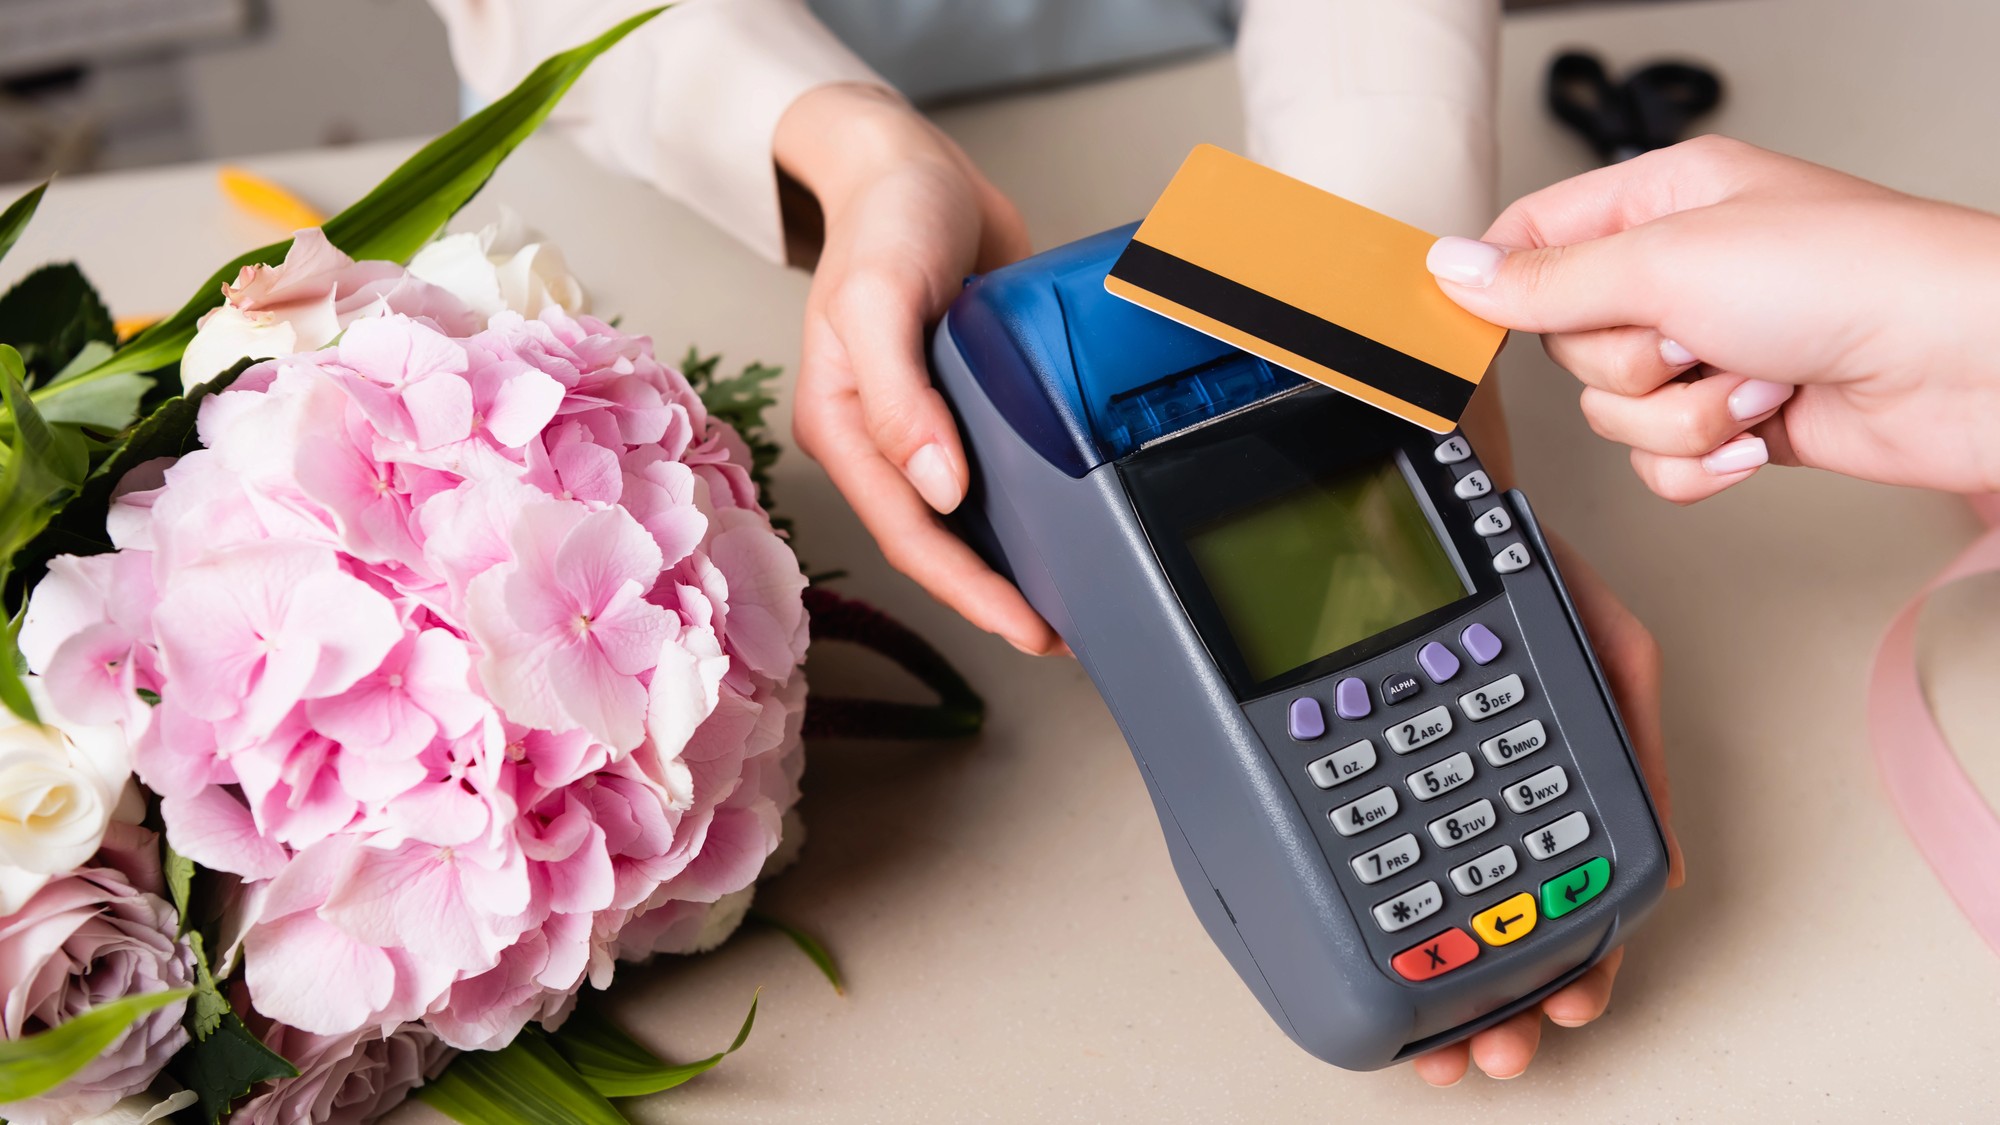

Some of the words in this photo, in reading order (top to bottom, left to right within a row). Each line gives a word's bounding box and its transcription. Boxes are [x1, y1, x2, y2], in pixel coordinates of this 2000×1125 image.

[1449, 442, 1463, 456] F1
[1469, 477, 1484, 491] F2
[1489, 514, 1504, 528] F3
[1508, 550, 1523, 564] F4
[1390, 678, 1416, 695] ALPHA
[1490, 692, 1512, 708] DEF
[1420, 722, 1444, 740] ABC
[1512, 736, 1539, 754] MNO
[1443, 772, 1464, 787] JKL
[1534, 782, 1560, 800] WXY
[1365, 805, 1387, 822] GHI
[1462, 815, 1487, 834] TUV
[1386, 852, 1410, 870] PRS
